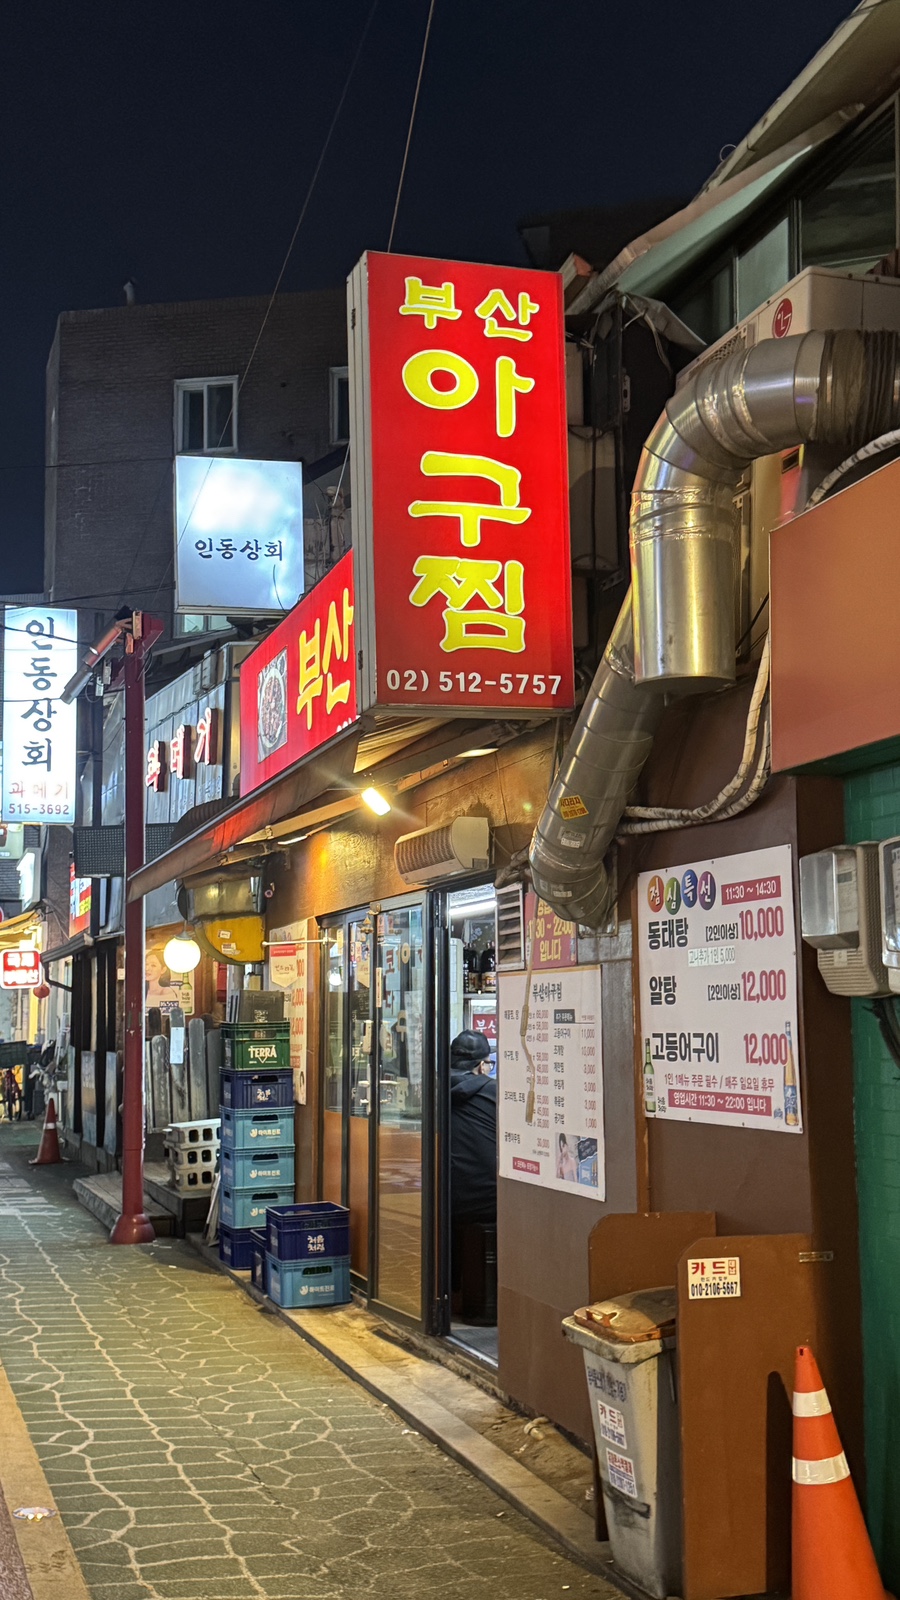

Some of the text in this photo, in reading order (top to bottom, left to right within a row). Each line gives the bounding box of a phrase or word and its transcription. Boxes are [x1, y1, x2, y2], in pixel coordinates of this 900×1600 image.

[399, 277, 539, 341] 부산
[402, 349, 534, 653] 아구찜
[194, 538, 283, 561] 인동상회
[297, 588, 354, 730] 부산
[386, 669, 562, 695] 02) 512-5757
[21, 617, 58, 772] 인동상회
[9, 781, 69, 799] 과메기
[8, 803, 70, 815] 515-3692
[649, 873, 712, 909] 점심특선
[725, 885, 744, 900] 11:30
[755, 880, 777, 896] 14:30
[648, 905, 784, 950] 동태탕 [2인이상] 10,000
[540, 938, 561, 962] 입니다
[720, 947, 735, 965] 5,000
[532, 982, 562, 1002] 부산아구찜
[650, 969, 787, 1005] 알탕 [2인이상] 12,000
[248, 1045, 278, 1058] TERRA
[652, 1032, 788, 1066] 고등어구이 12,000
[664, 1073, 673, 1086] 1인
[675, 1073, 689, 1087] 1메뉴
[691, 1074, 703, 1087] 주문
[705, 1075, 718, 1088] 필수
[740, 1076, 759, 1091] 일요일
[761, 1077, 775, 1092] 휴무
[673, 1091, 697, 1106] 영업시간
[698, 1094, 716, 1107] 11:30
[725, 1096, 745, 1110] 22:00
[746, 1097, 767, 1113] 입니다
[691, 1261, 726, 1276] 카드
[691, 1281, 738, 1297] 010-2106-5667
